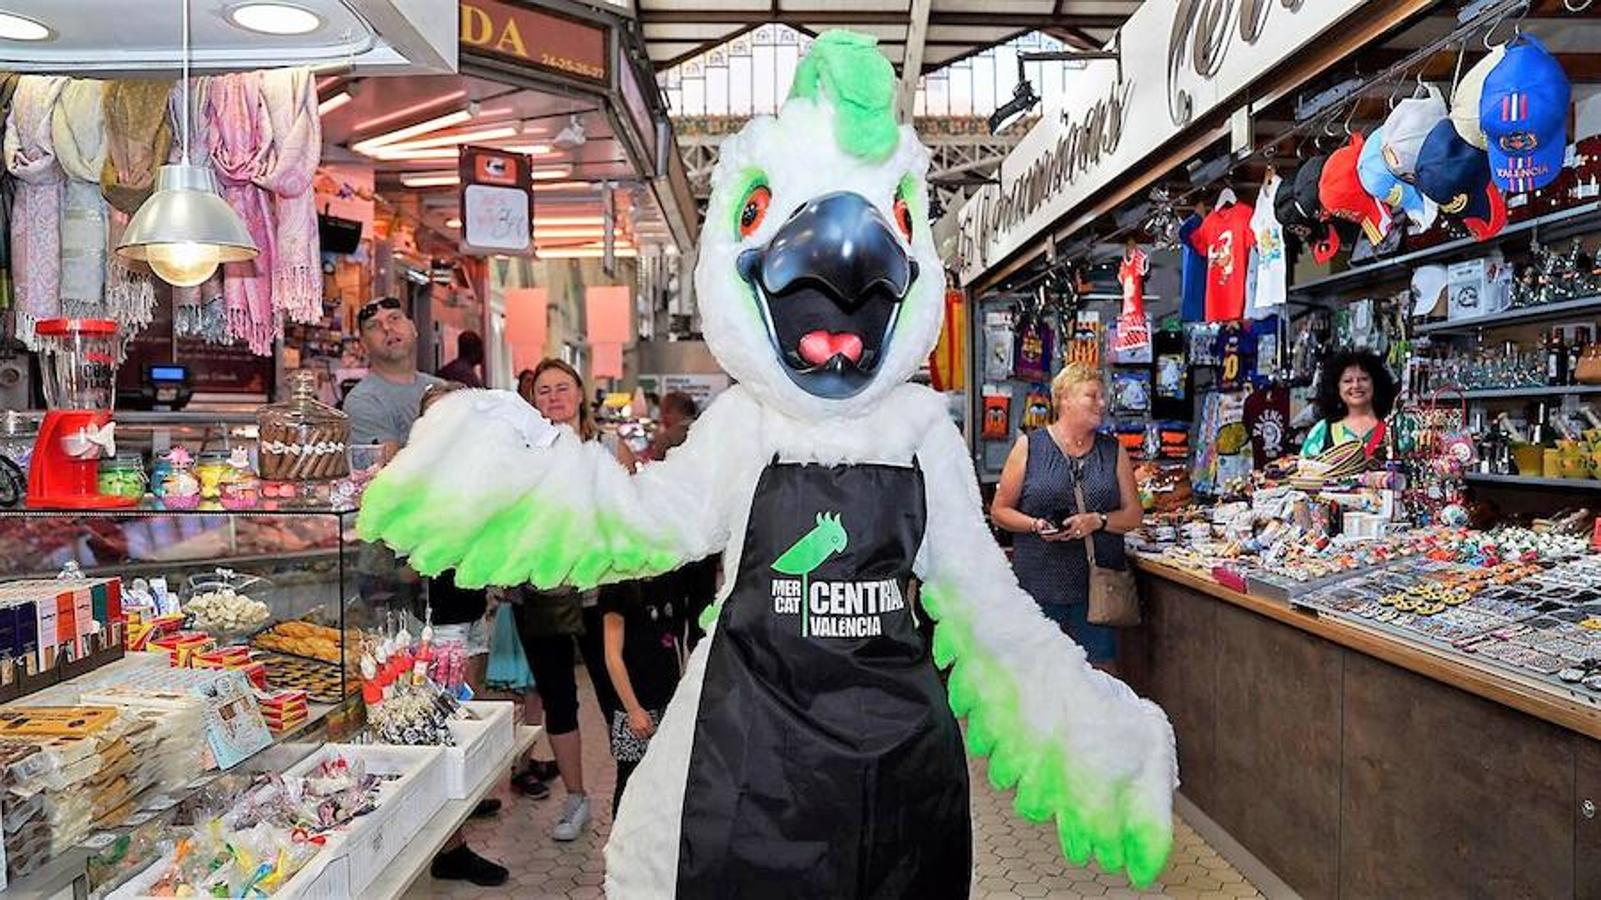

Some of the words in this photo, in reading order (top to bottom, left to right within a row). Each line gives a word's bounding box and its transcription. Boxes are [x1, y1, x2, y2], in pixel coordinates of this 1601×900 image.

[460, 4, 530, 57] DA
[771, 580, 801, 597] MER
[774, 597, 801, 613] CAT
